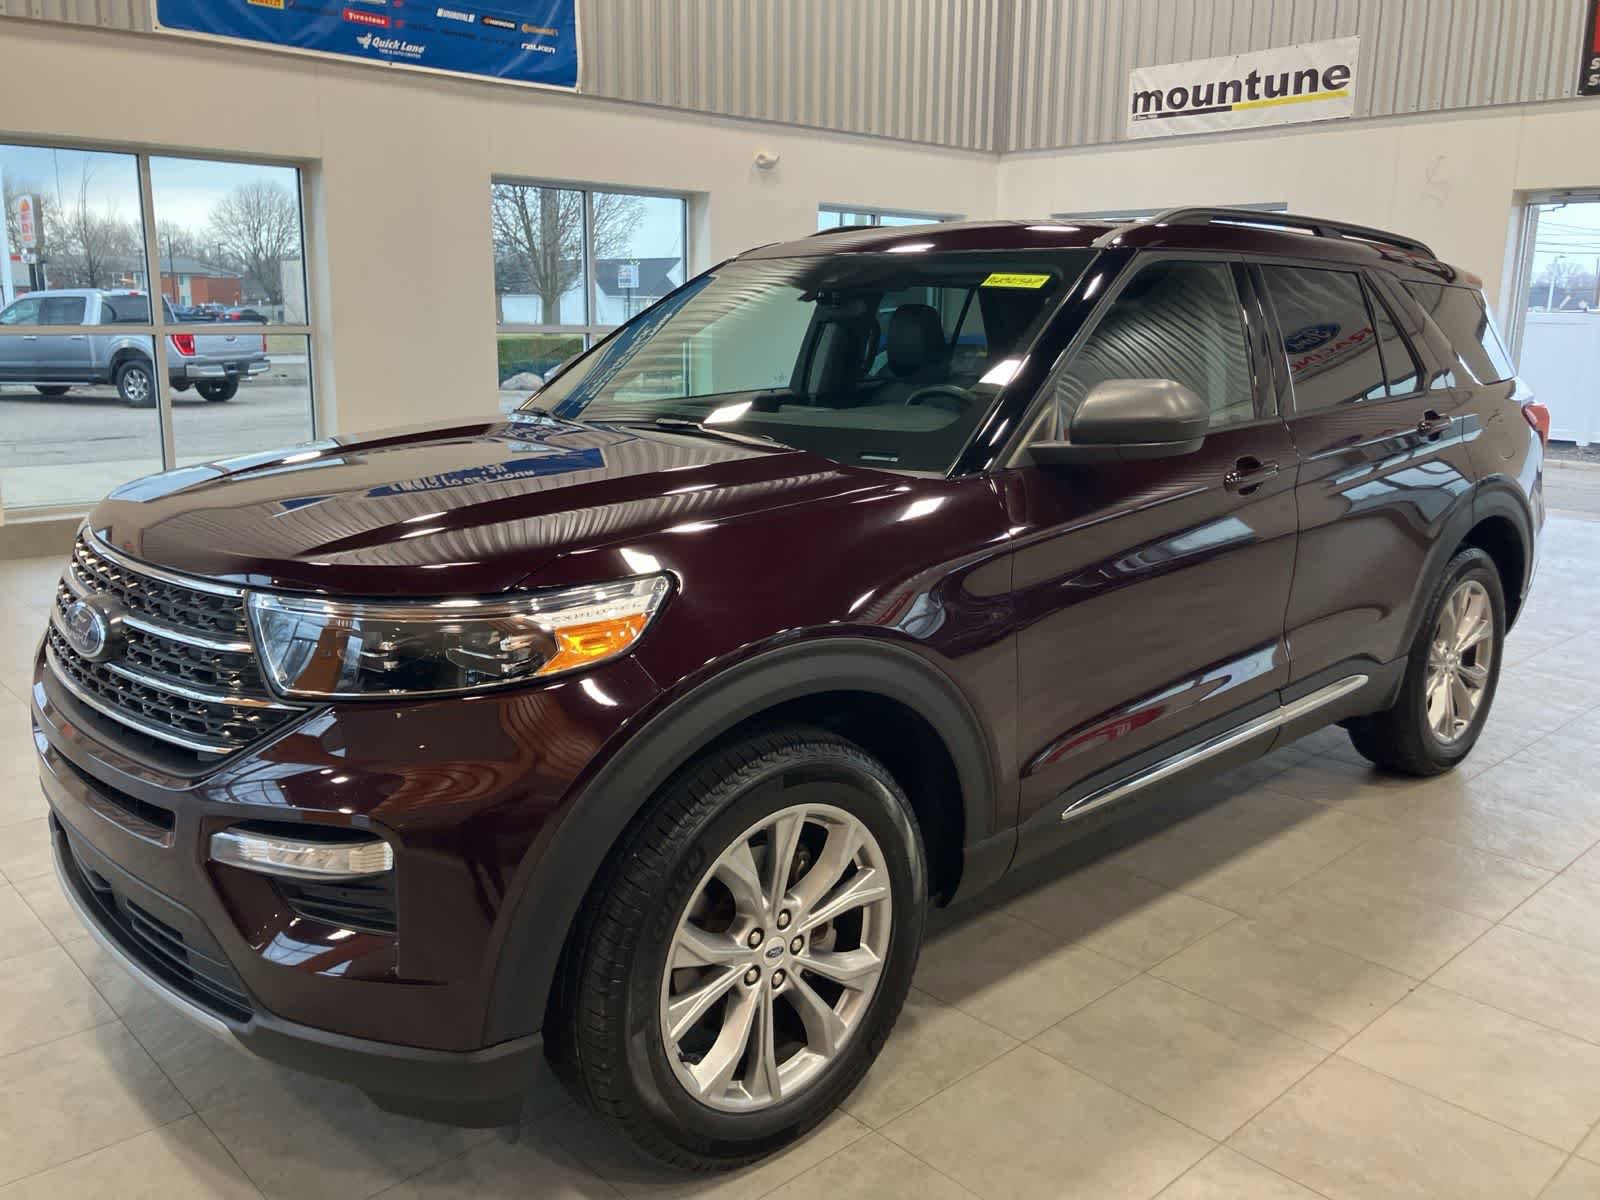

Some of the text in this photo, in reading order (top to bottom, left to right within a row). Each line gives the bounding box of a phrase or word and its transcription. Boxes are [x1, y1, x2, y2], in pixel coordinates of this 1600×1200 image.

[371, 36, 401, 49] Quick
[400, 41, 426, 54] Lane
[1132, 64, 1351, 114] mountune
